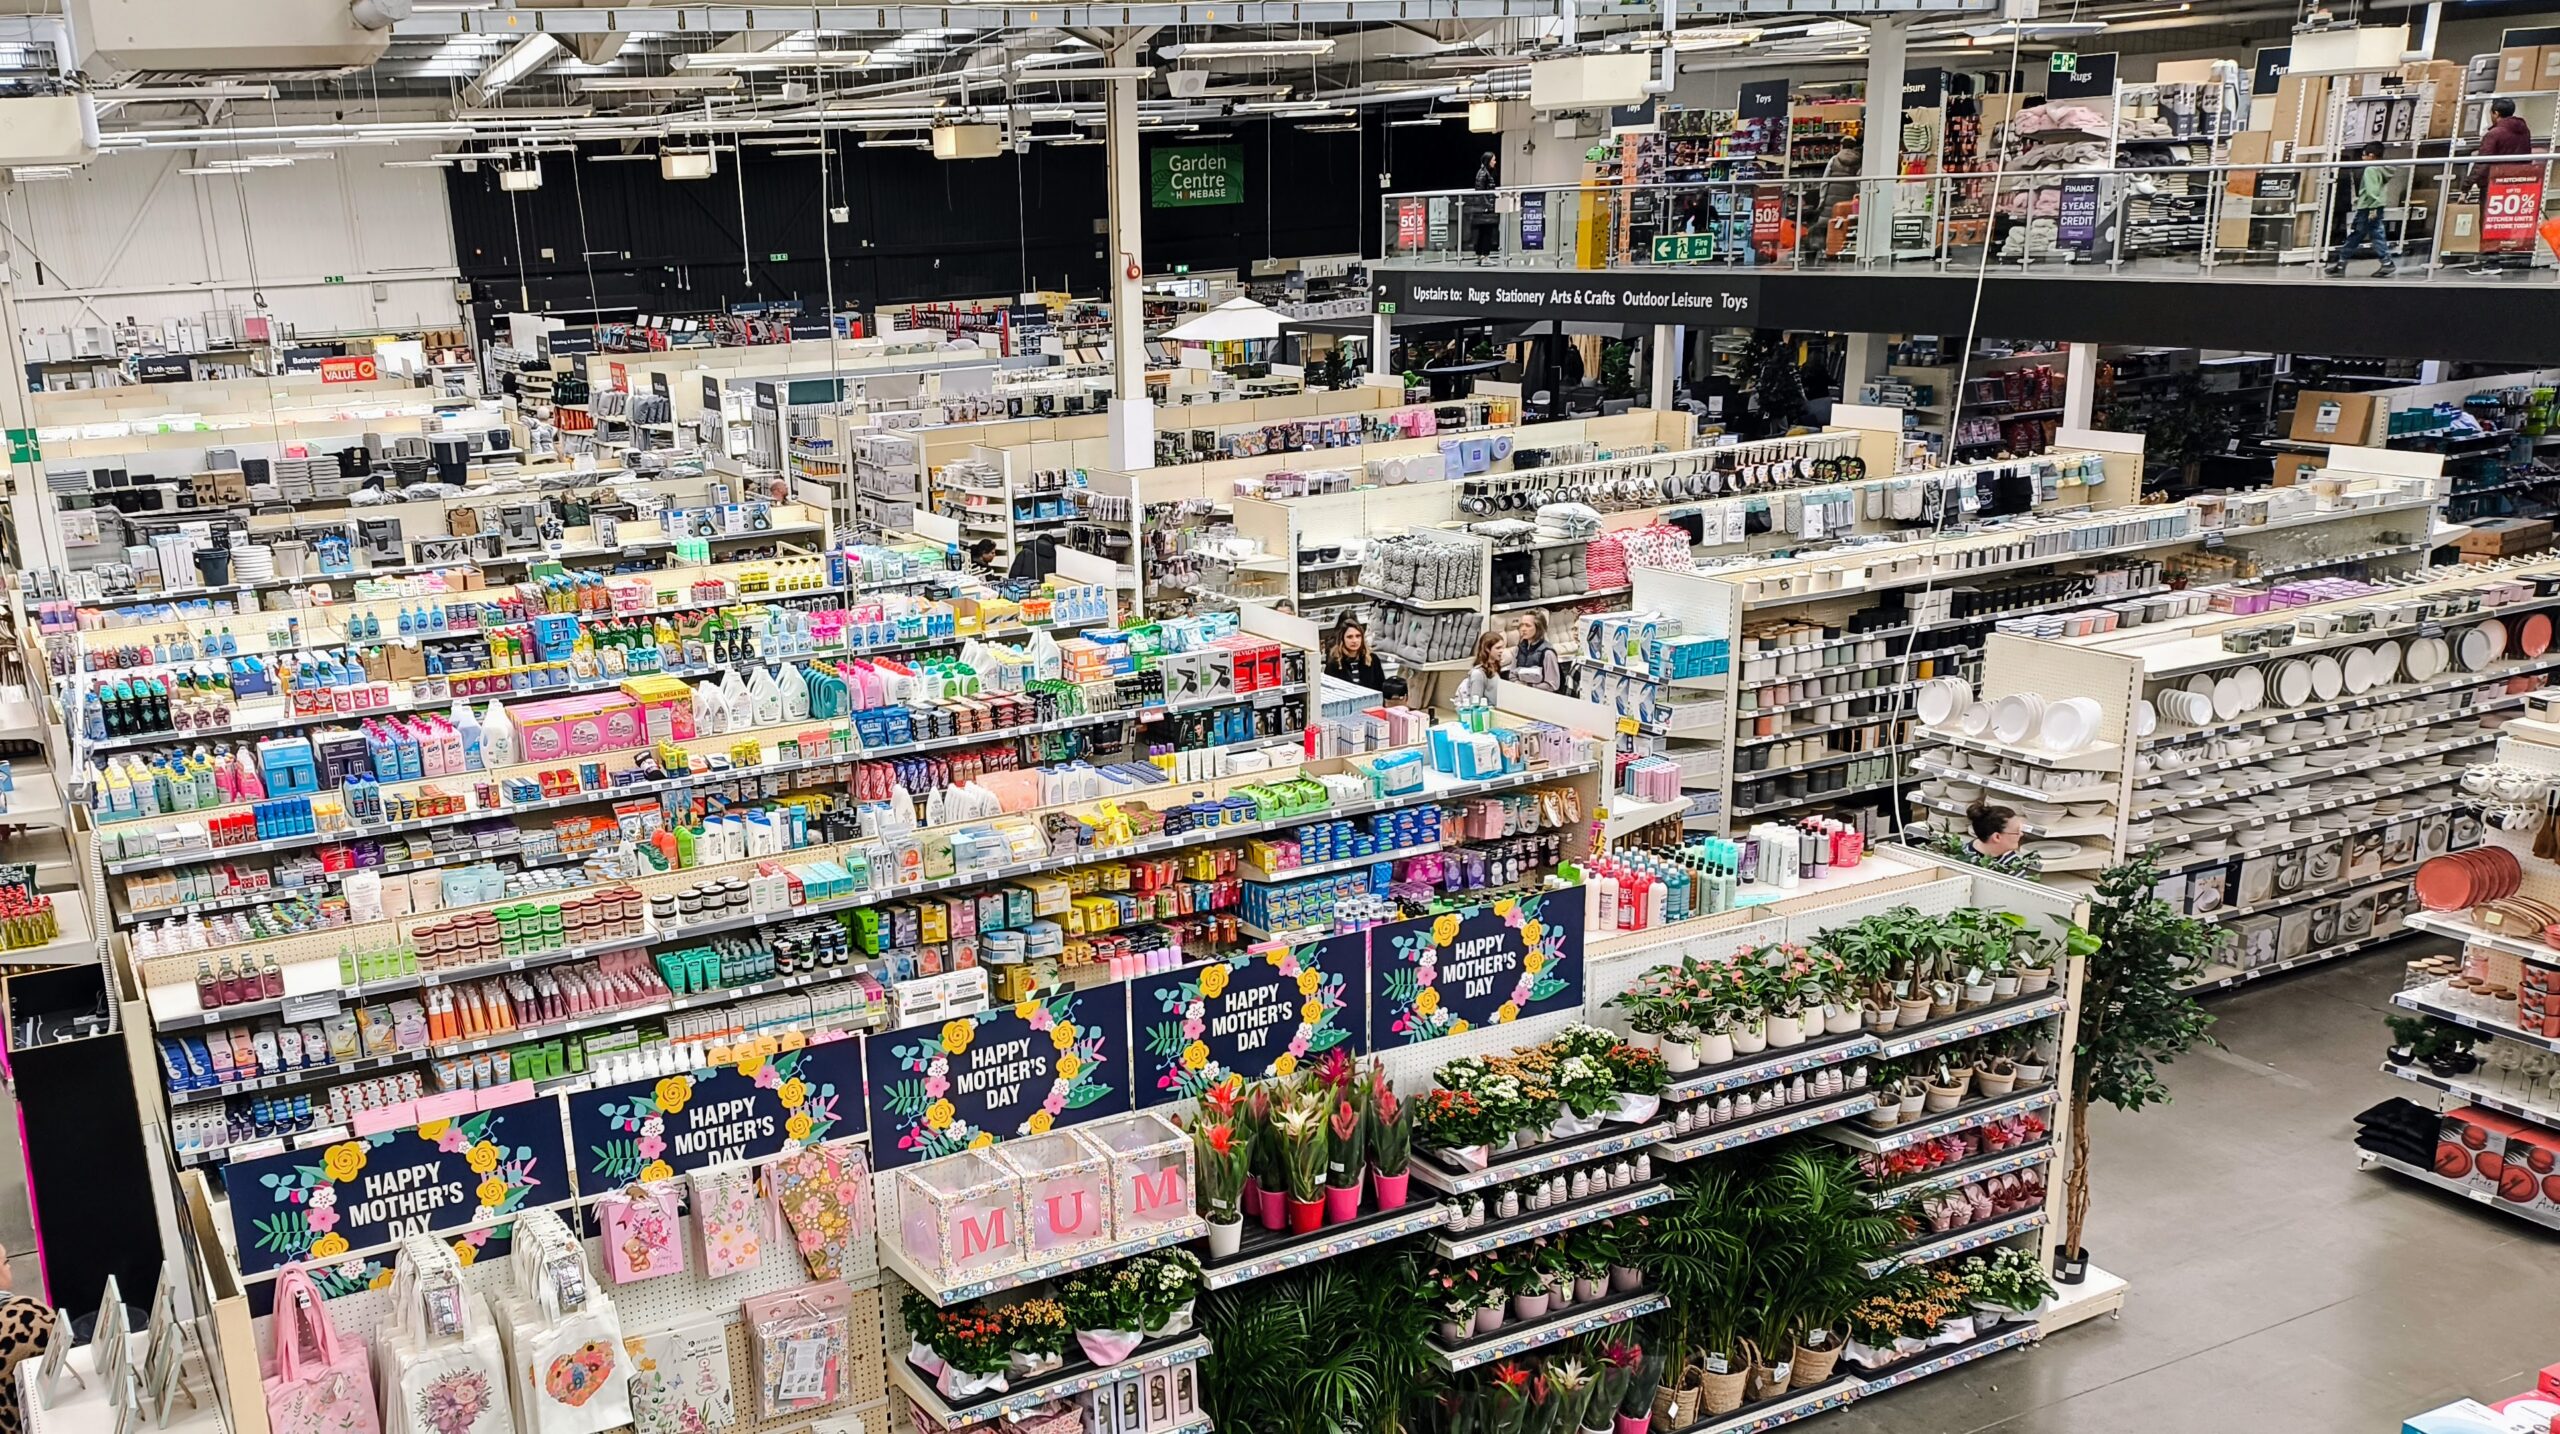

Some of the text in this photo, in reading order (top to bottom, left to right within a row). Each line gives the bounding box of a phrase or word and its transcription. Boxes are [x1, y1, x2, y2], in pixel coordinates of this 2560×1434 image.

[2070, 71, 2093, 83] Rugs
[1756, 93, 1772, 105] Toys
[1169, 153, 1227, 172] Garden
[1171, 173, 1225, 189] Centre
[2065, 185, 2095, 193] FINANCE
[1755, 208, 1779, 223] 50%
[2069, 202, 2095, 210] YEARS
[2487, 193, 2535, 215] 50%
[2060, 216, 2094, 226] CREDIT
[1695, 238, 1708, 247] Fire
[1695, 247, 1707, 256] exit
[1413, 286, 1748, 310] Upstairs to: Rugs Stationery Arts & Crafts Outdoor Leisure Toys
[324, 370, 357, 381] VALUE
[1454, 934, 1506, 963] HAPPY
[1442, 951, 1517, 984] MOTHER'S
[1225, 983, 1280, 1013] HAPPY
[1465, 975, 1494, 1000] DAY
[1211, 1001, 1293, 1037] MOTHER'S
[1237, 1026, 1270, 1053] DAY
[970, 1037, 1032, 1070] HAPPY
[956, 1056, 1048, 1096] MOTHER'S
[986, 1083, 1022, 1111] DAY
[689, 1096, 757, 1130] HAPPY
[674, 1115, 775, 1157] MOTHER'S
[708, 1145, 747, 1167] DAY
[364, 1160, 442, 1199] HAPPY
[348, 1181, 465, 1229] MOTHER'S
[388, 1214, 433, 1243] DAY
